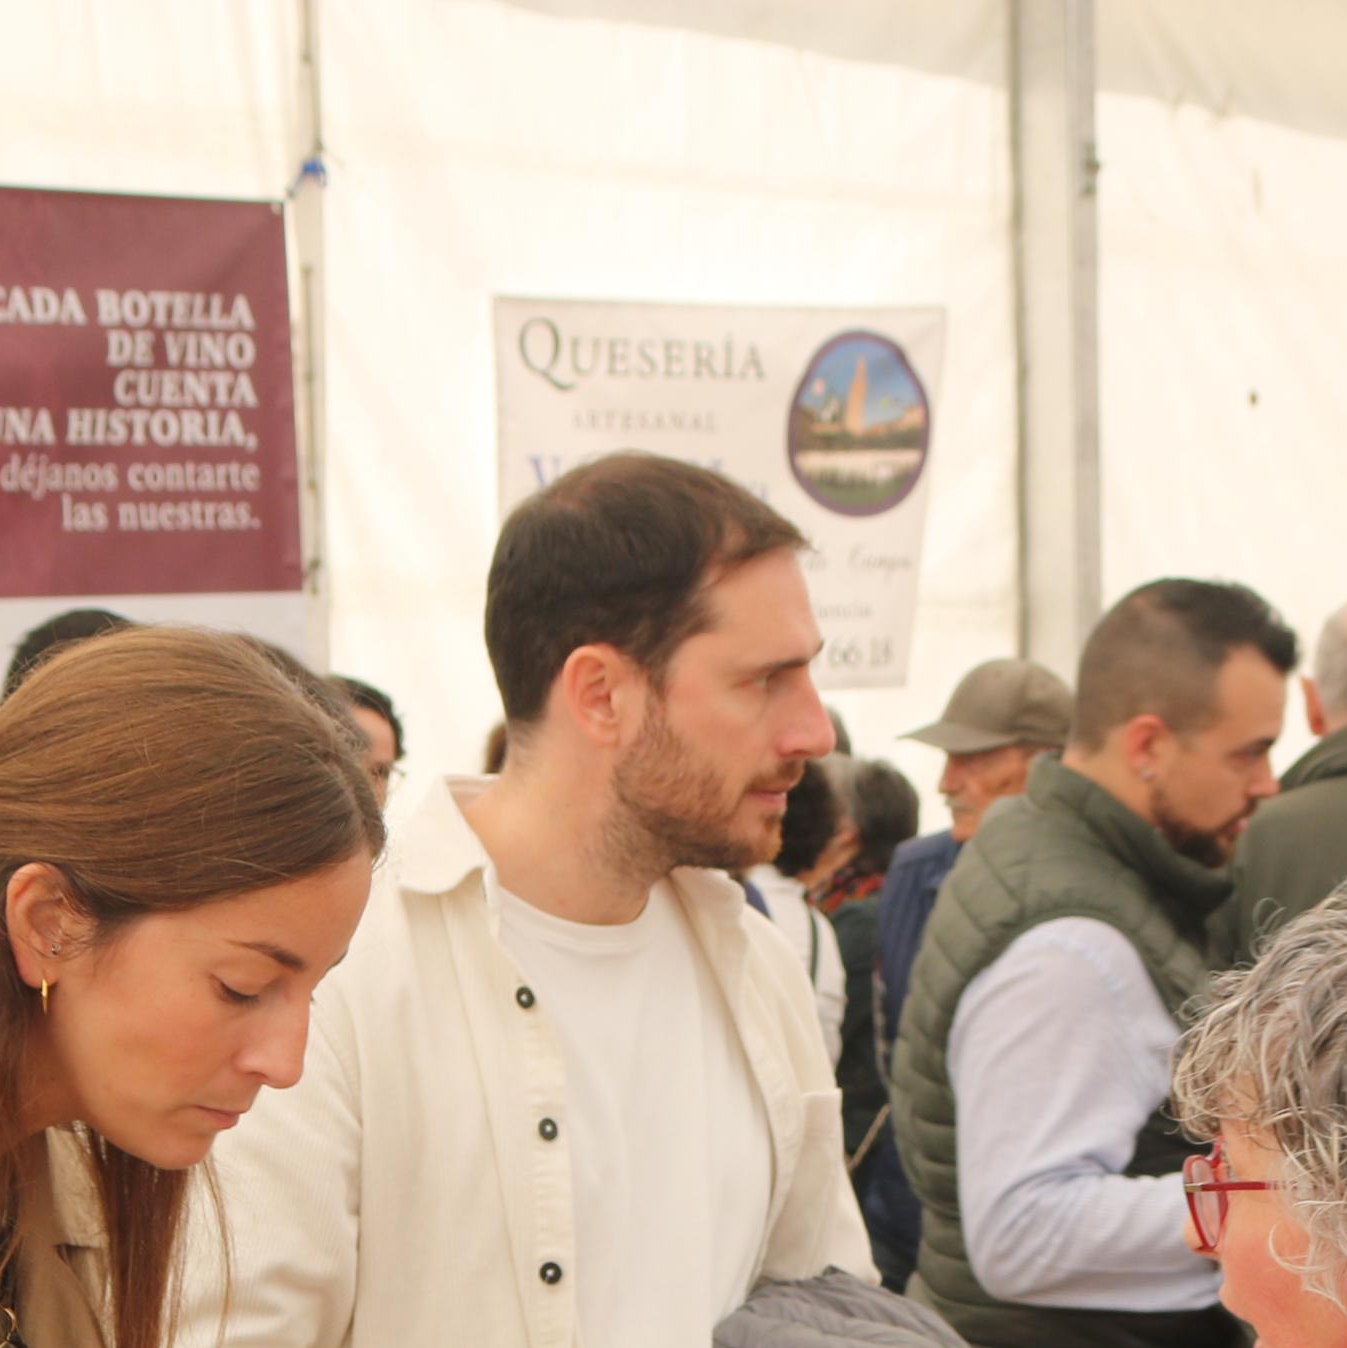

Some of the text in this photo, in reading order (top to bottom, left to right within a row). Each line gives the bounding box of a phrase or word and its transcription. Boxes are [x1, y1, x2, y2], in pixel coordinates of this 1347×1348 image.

[95, 288, 255, 331] BOTELLA
[106, 328, 255, 370] DE VINO
[518, 315, 766, 392] QUESERÍA
[113, 369, 259, 408] CUENTA
[65, 408, 258, 454] HISTORIA,
[571, 408, 718, 433] ARTESANAL
[0, 452, 260, 500] déjanos contarte
[61, 492, 262, 532] las nuestras.
